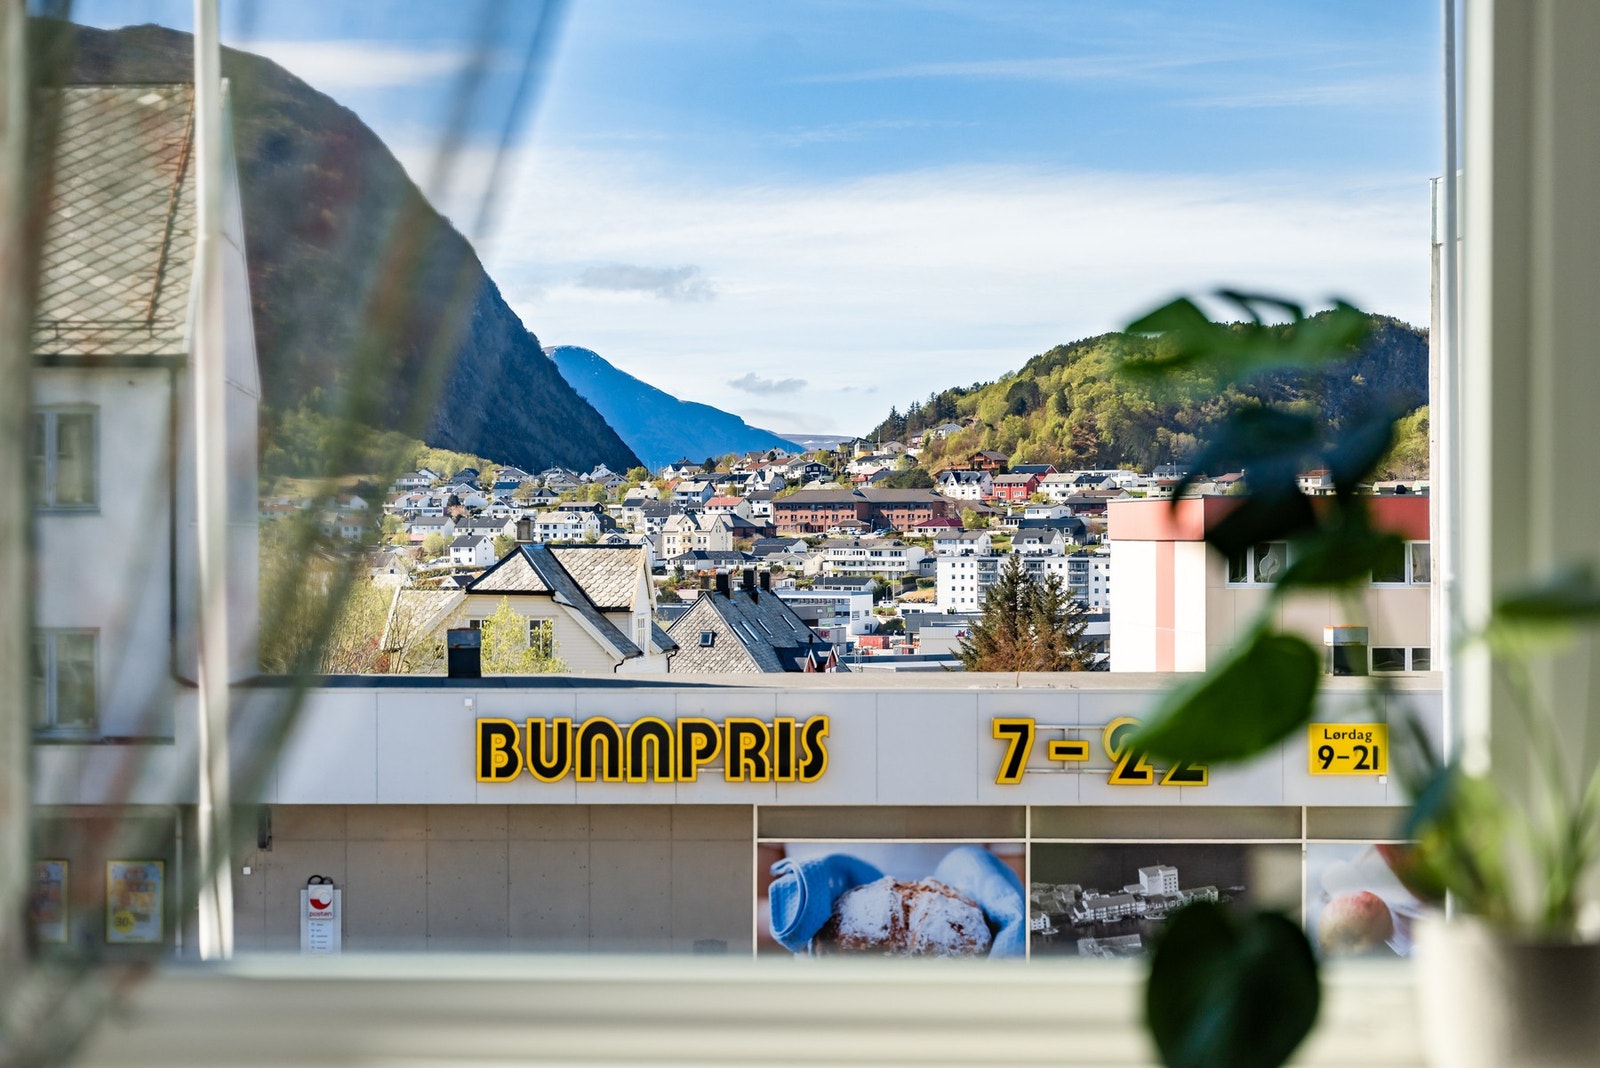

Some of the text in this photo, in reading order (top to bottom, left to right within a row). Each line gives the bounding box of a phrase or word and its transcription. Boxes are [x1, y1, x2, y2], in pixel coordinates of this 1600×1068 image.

[1324, 728, 1372, 743] Lørdag
[476, 715, 829, 783] BUNNPRIS
[1318, 745, 1378, 770] 9-21
